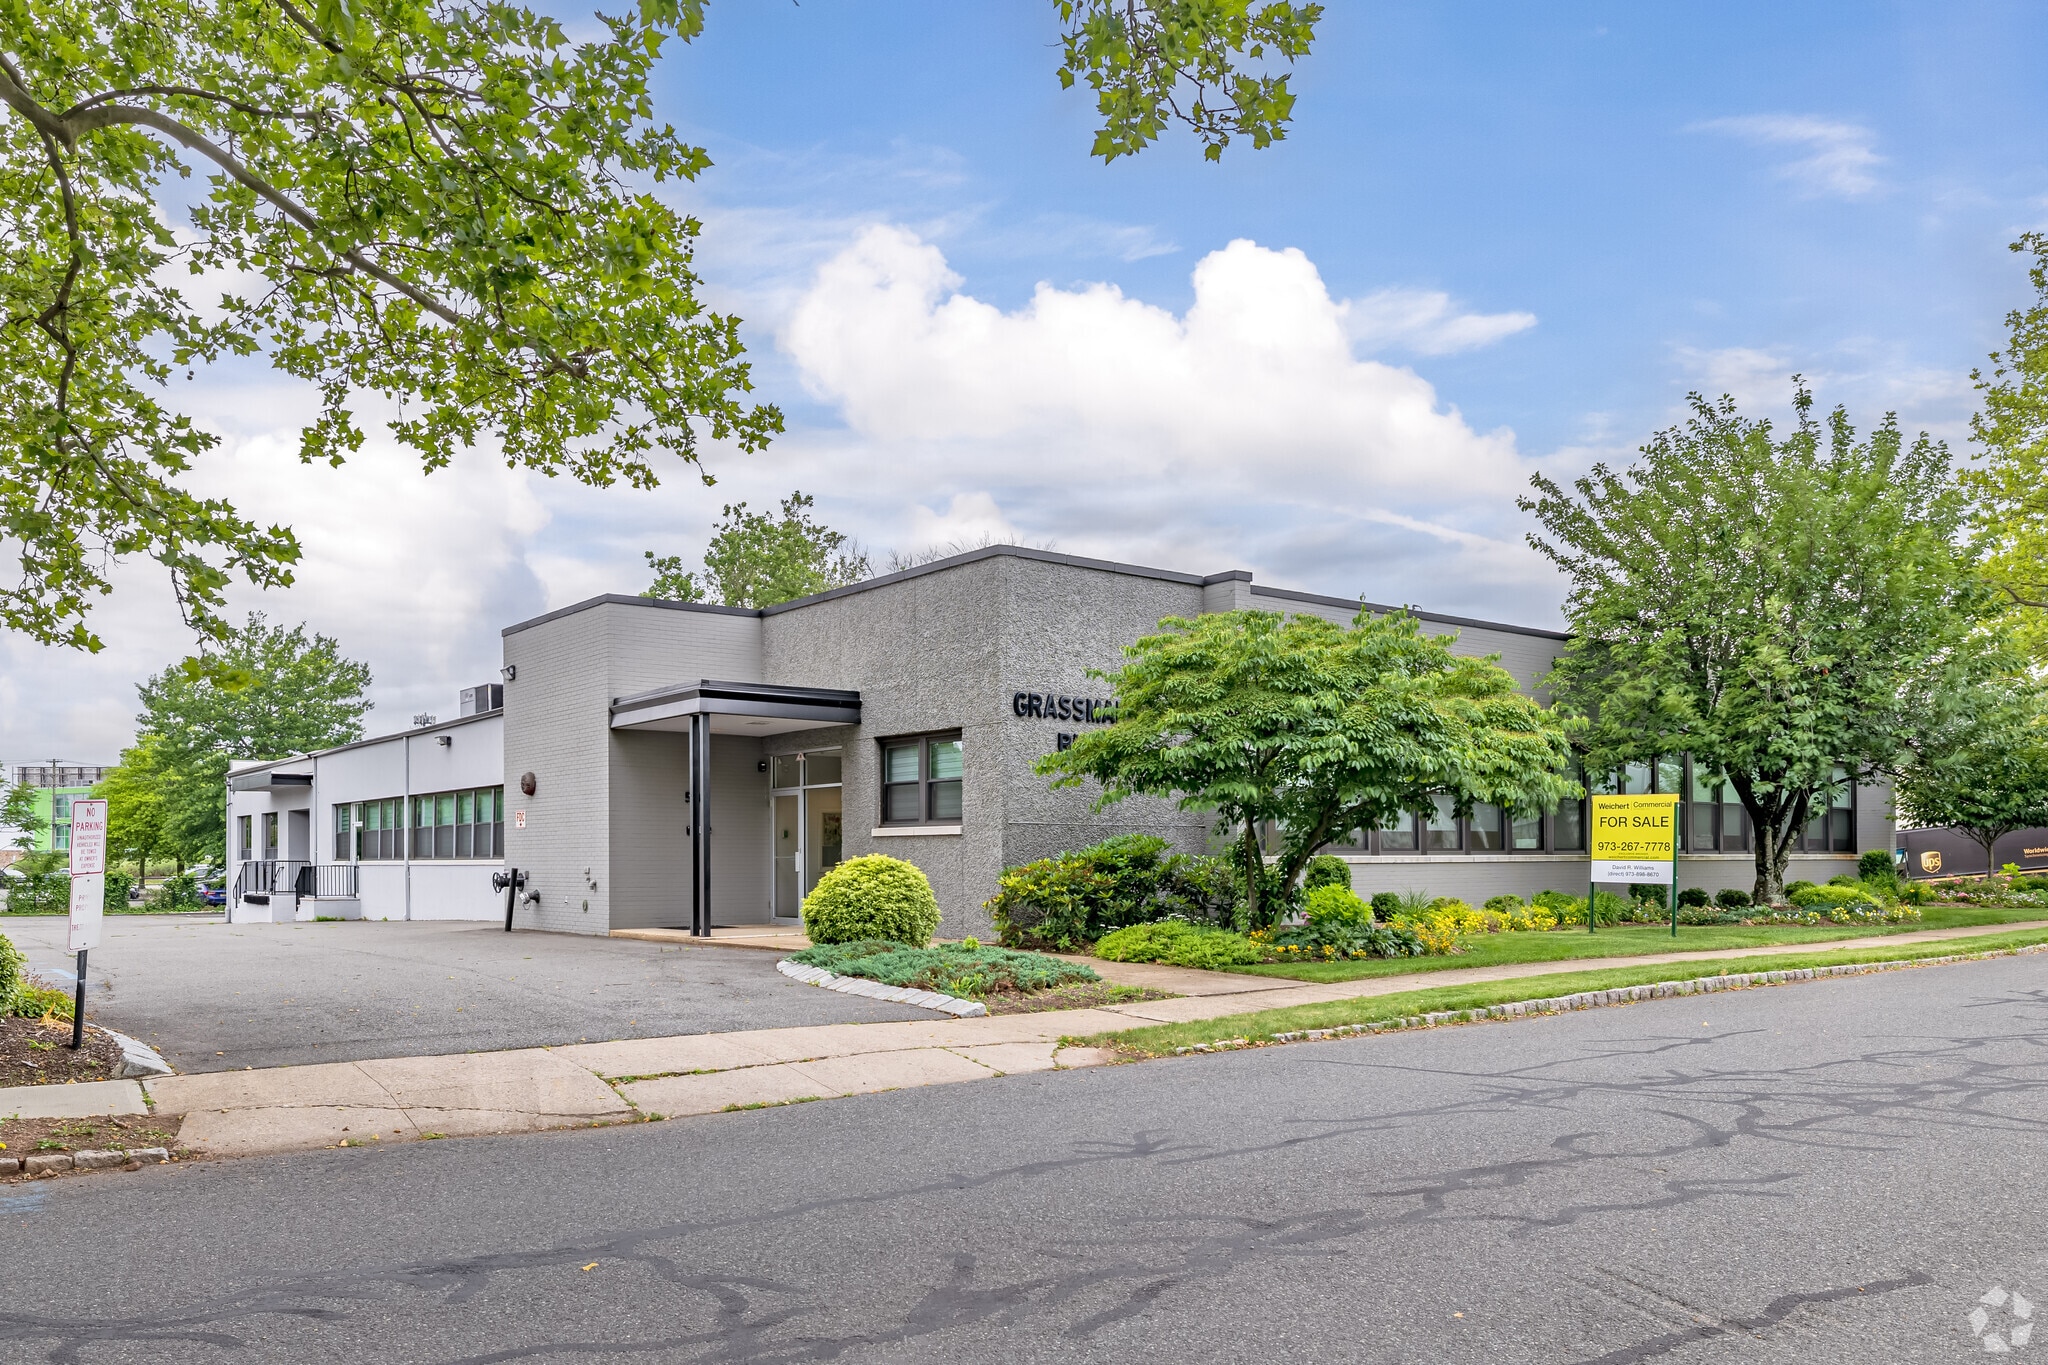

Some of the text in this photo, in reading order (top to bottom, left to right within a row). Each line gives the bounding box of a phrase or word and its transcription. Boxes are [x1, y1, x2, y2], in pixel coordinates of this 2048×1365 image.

[1013, 691, 1119, 724] GRASSMA
[86, 808, 96, 818] NO
[75, 821, 104, 832] PARKING
[1599, 816, 1669, 828] FOR SALE
[1597, 841, 1671, 852] 973-267-7778
[1923, 857, 1940, 870] ups
